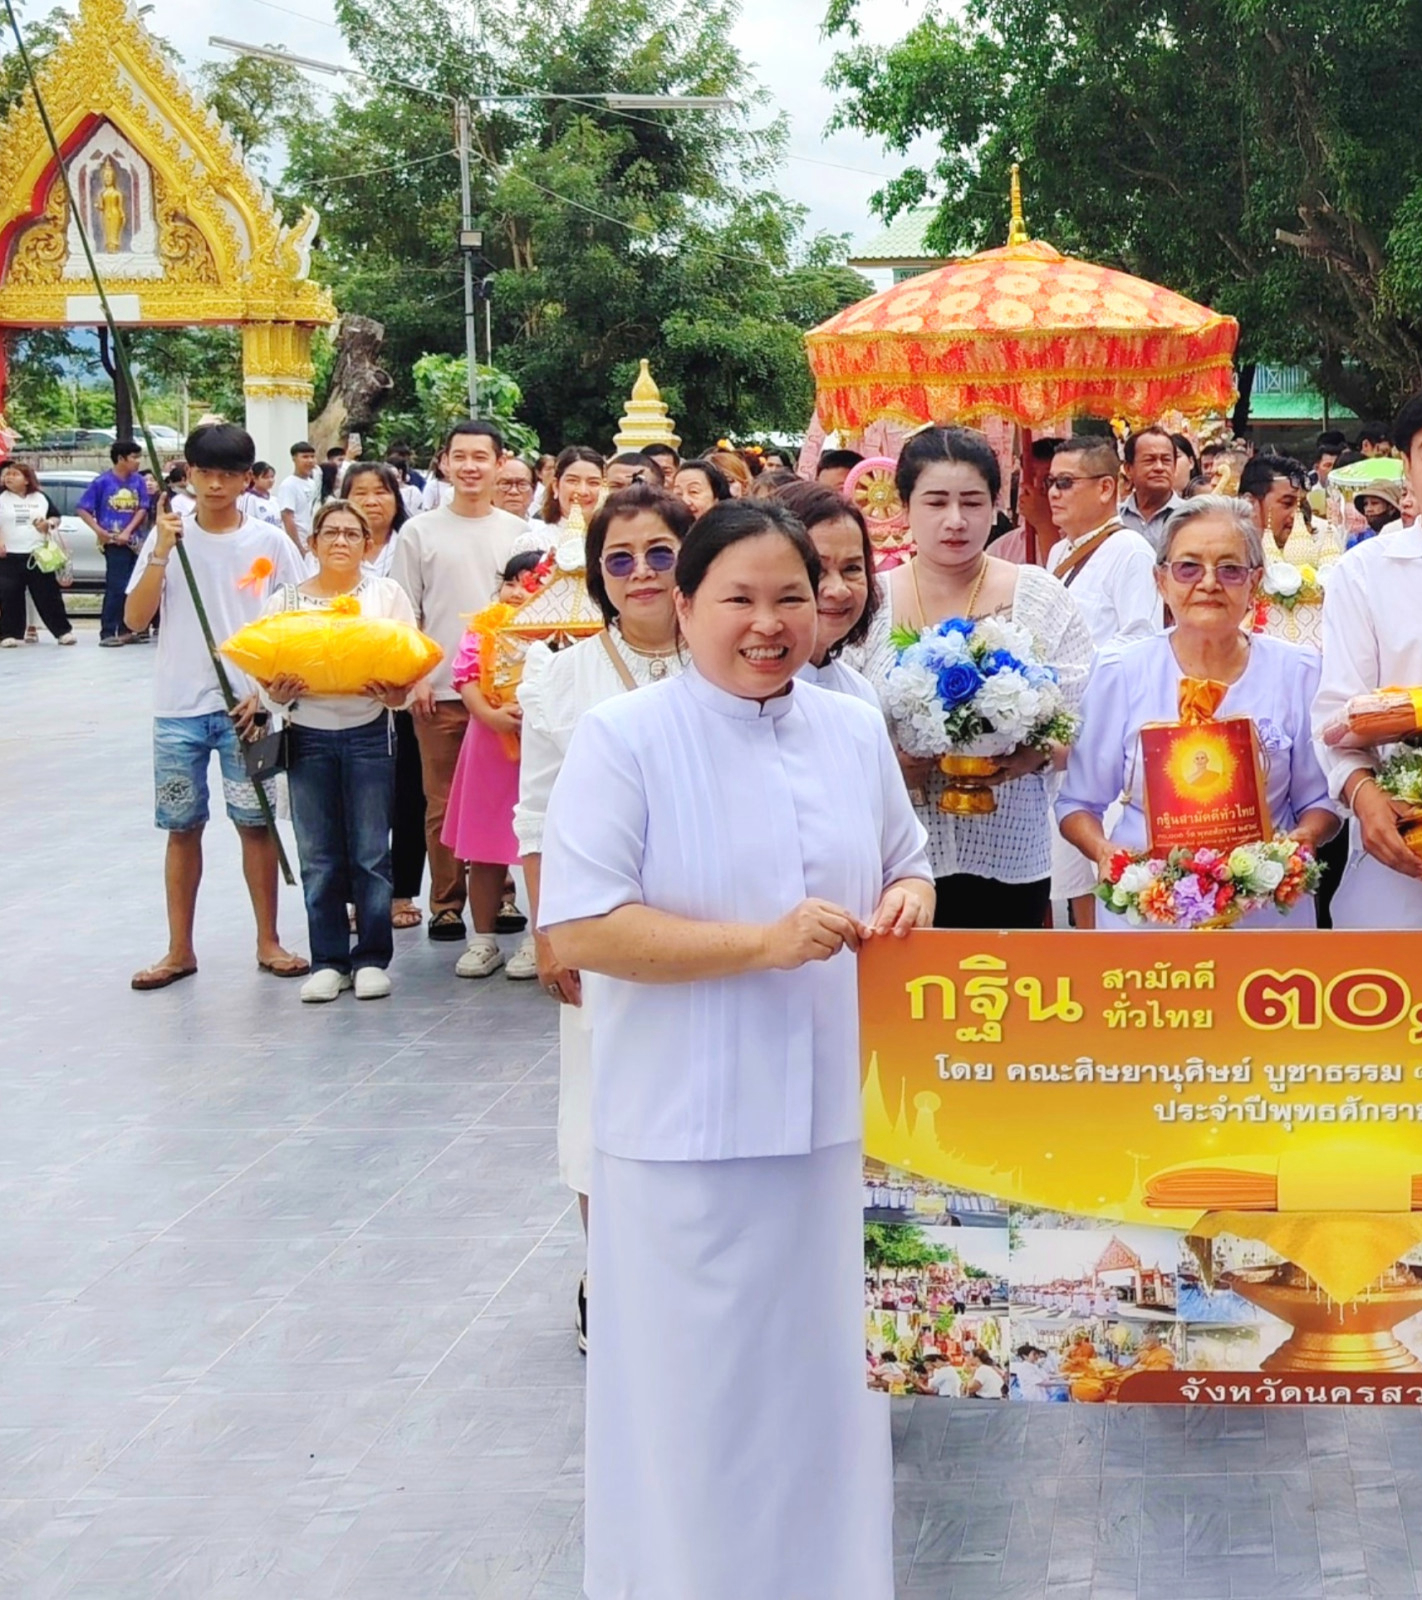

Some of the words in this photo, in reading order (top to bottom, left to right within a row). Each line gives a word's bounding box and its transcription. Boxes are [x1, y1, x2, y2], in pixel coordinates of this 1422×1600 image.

[1156, 804, 1255, 829] กฐินสามัคคีทั่วไทย
[1101, 959, 1216, 989] สามัคคี
[905, 953, 1083, 1042] กฐิน
[1102, 992, 1214, 1029] ทั่วไทย
[934, 1053, 993, 1082] โดย
[1006, 1056, 1252, 1093] คณะศิษยานุศิษย์
[1264, 1059, 1402, 1092] บูชาธรรม
